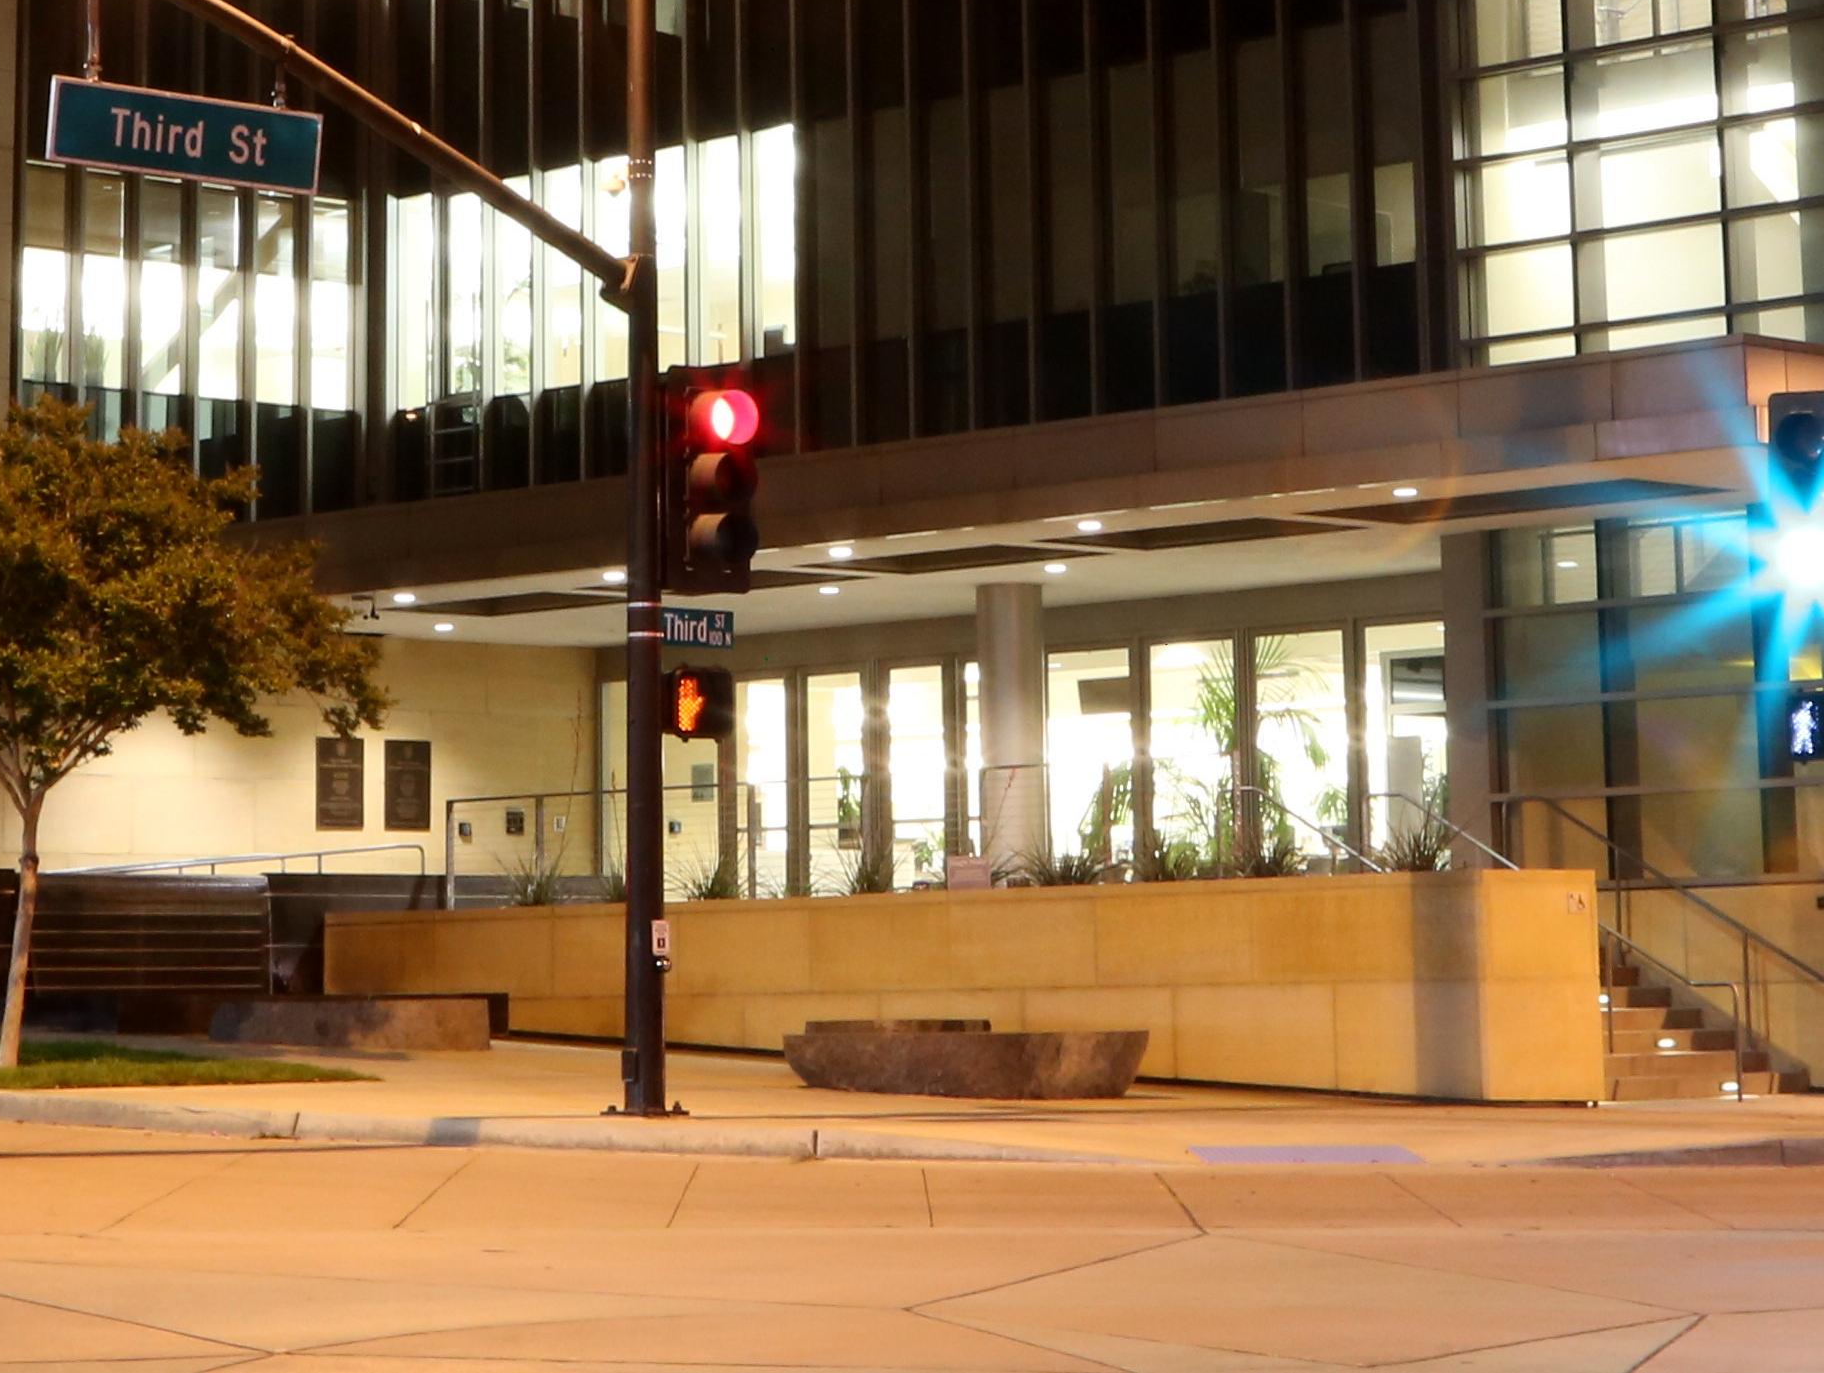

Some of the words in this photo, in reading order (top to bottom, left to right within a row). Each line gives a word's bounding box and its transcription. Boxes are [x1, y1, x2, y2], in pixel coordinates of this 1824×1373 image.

[111, 106, 205, 158] Third
[229, 124, 268, 167] St
[663, 612, 708, 643] Third
[714, 613, 726, 628] ST
[724, 631, 732, 645] N
